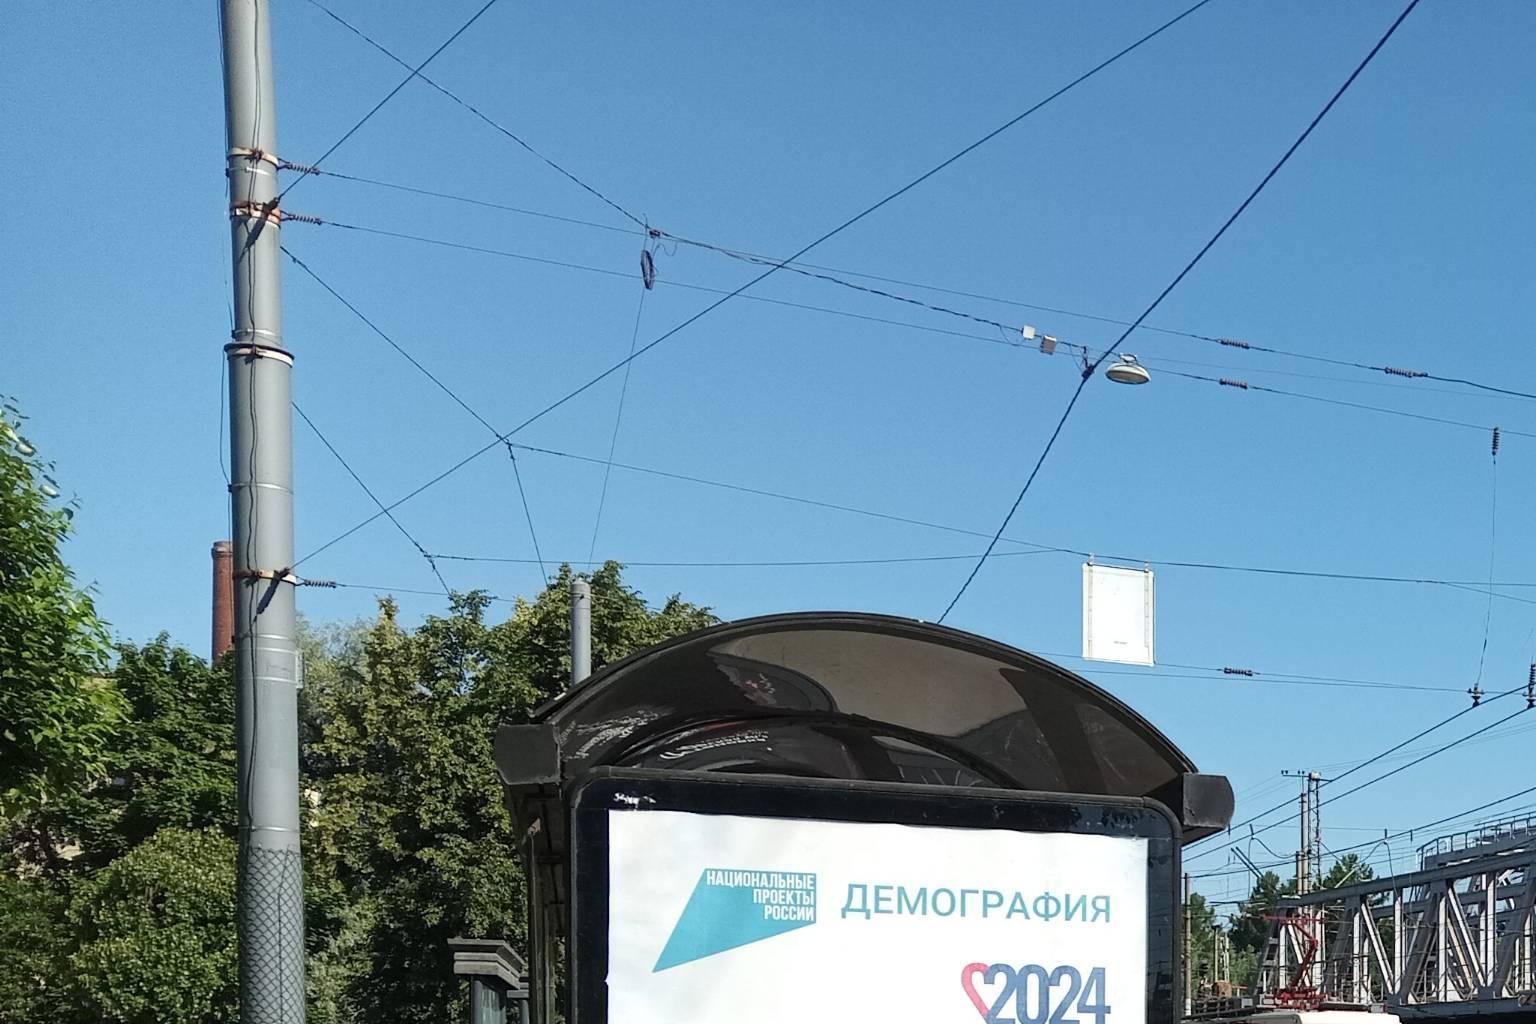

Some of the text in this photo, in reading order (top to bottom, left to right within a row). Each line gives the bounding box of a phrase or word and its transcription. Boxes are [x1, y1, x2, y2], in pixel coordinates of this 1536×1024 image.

[706, 870, 815, 890] НАЦИОНАЛЬНЫЕ
[753, 888, 815, 906] ПРОЕКТЫ
[841, 883, 1111, 923] ДЕМОГРАФИЯ
[764, 905, 815, 922] РОССИИ
